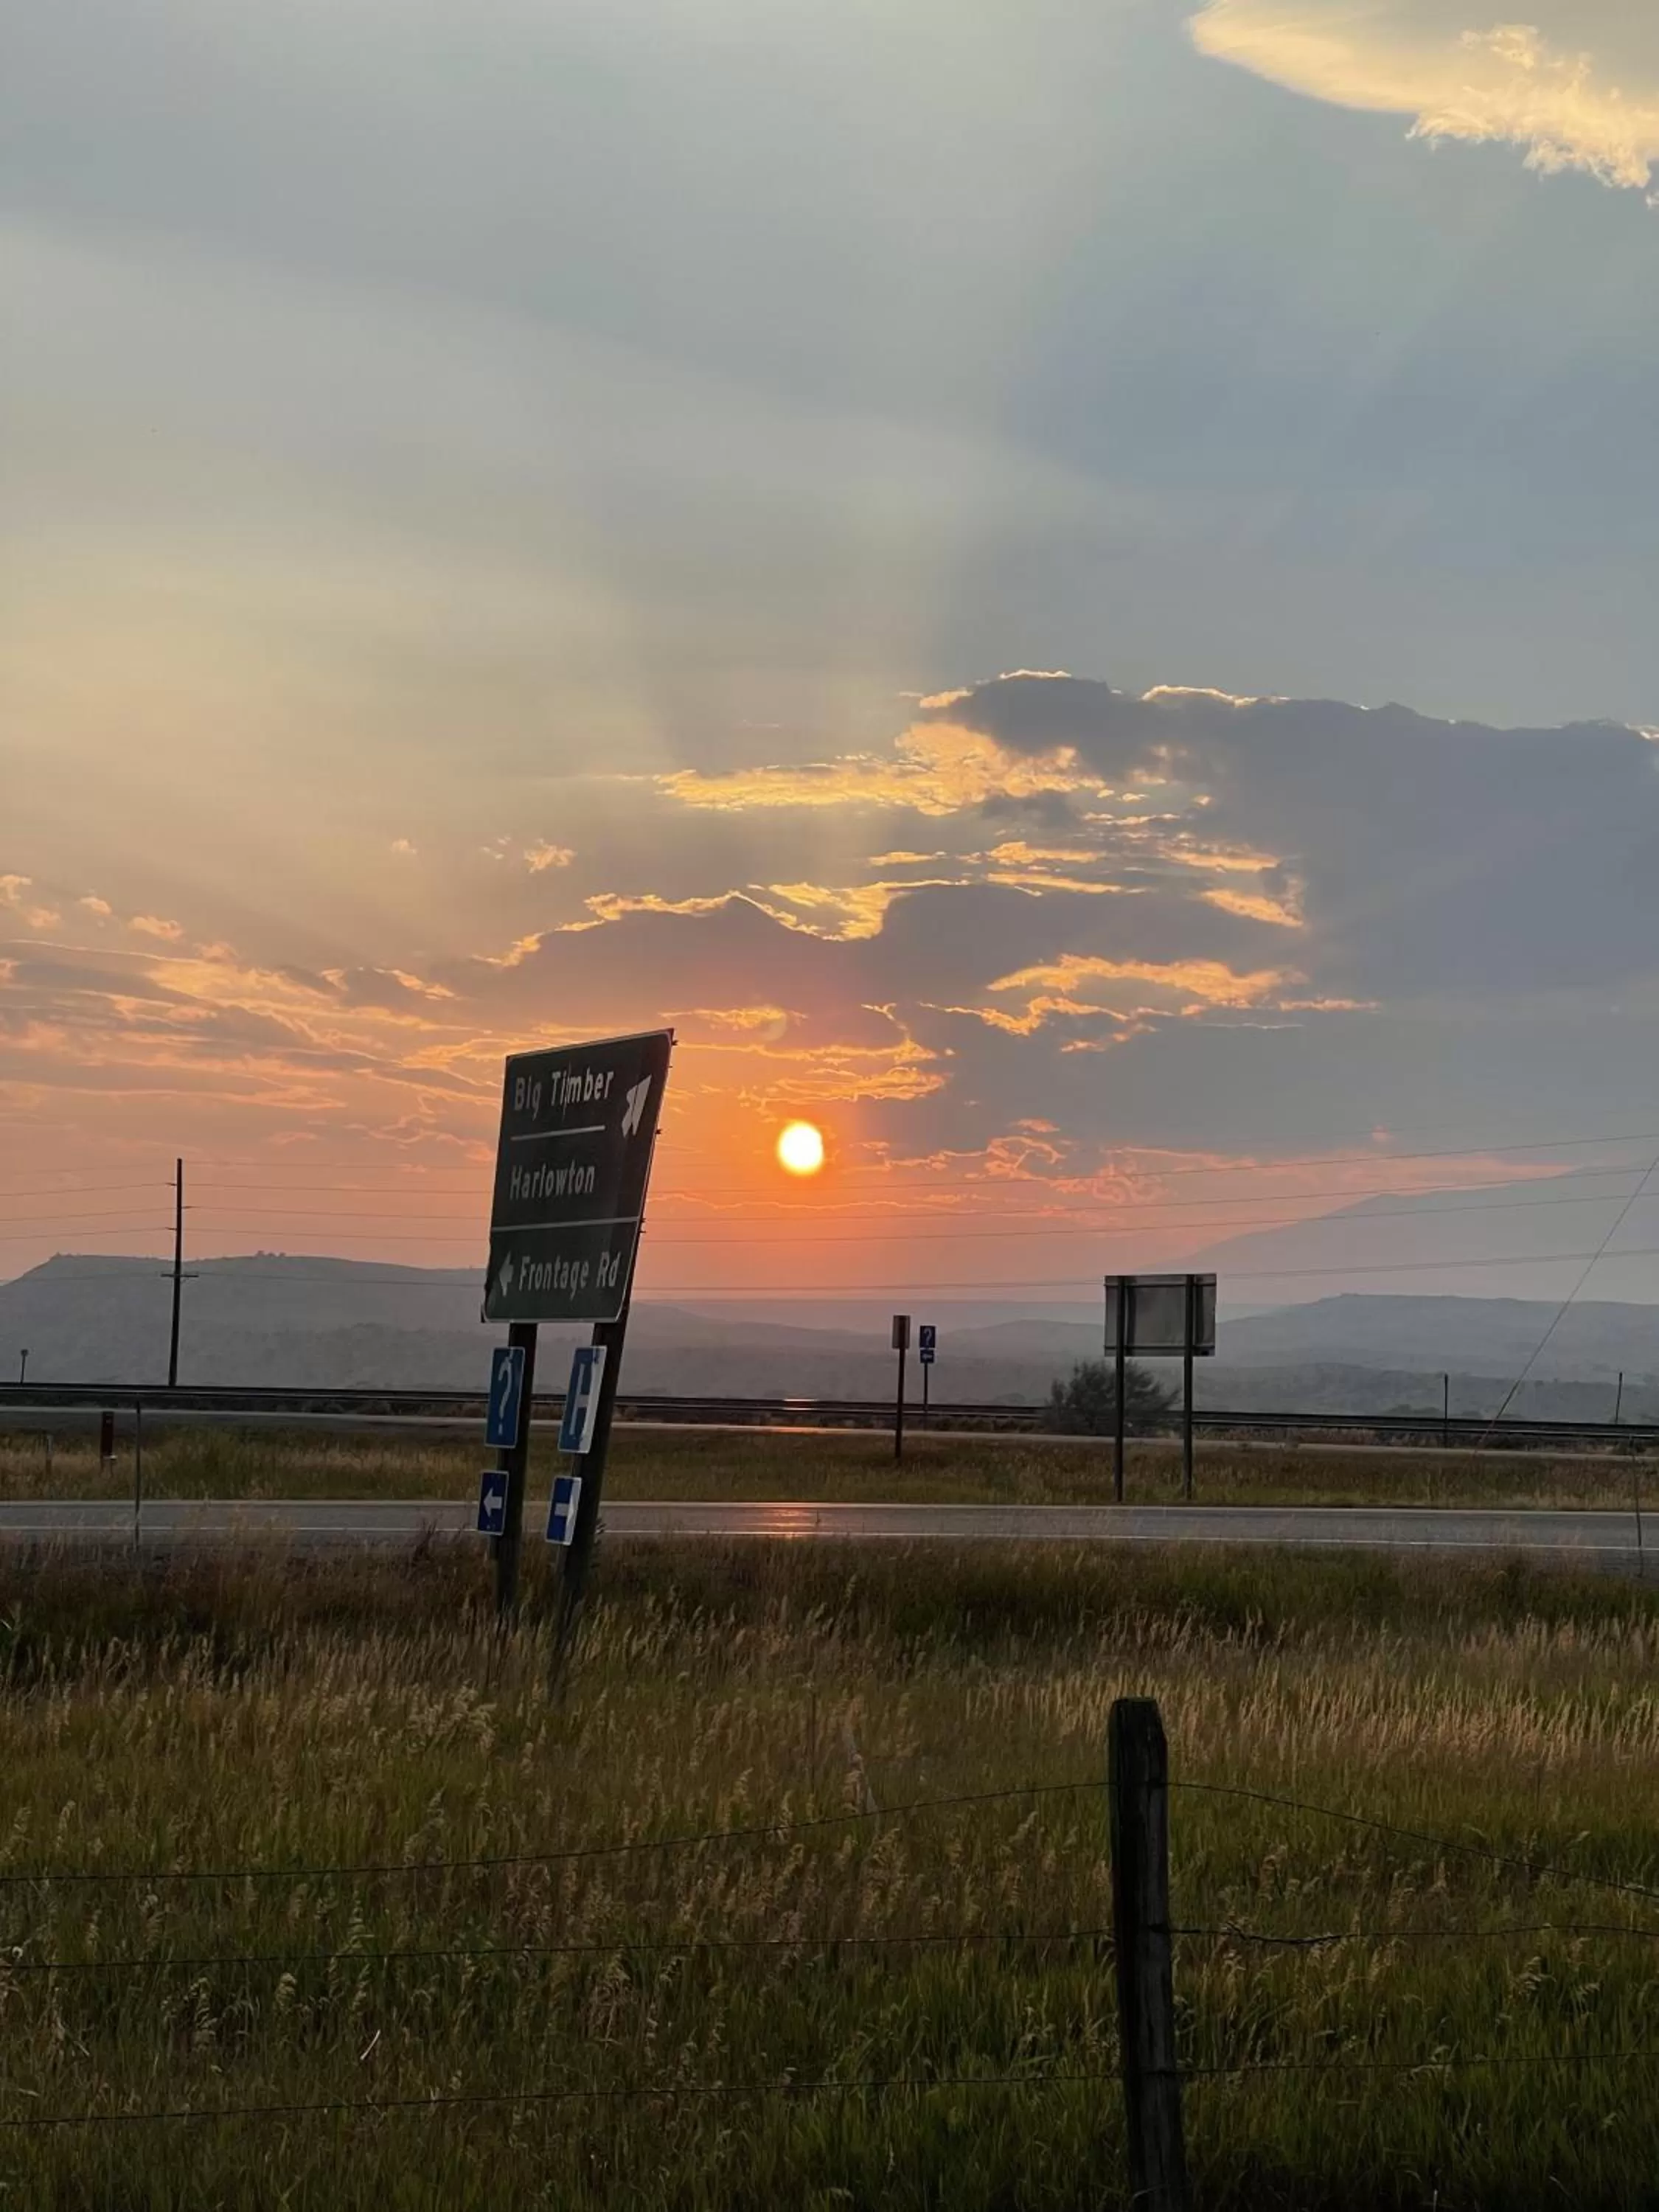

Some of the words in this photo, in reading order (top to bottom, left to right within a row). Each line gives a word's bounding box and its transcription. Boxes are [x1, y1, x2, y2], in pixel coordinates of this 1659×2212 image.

[515, 1076, 541, 1121] Big
[551, 1066, 614, 1108] Timber
[509, 1159, 595, 1200] Harlowton
[518, 1256, 588, 1300] Frontage
[596, 1251, 620, 1289] Rd
